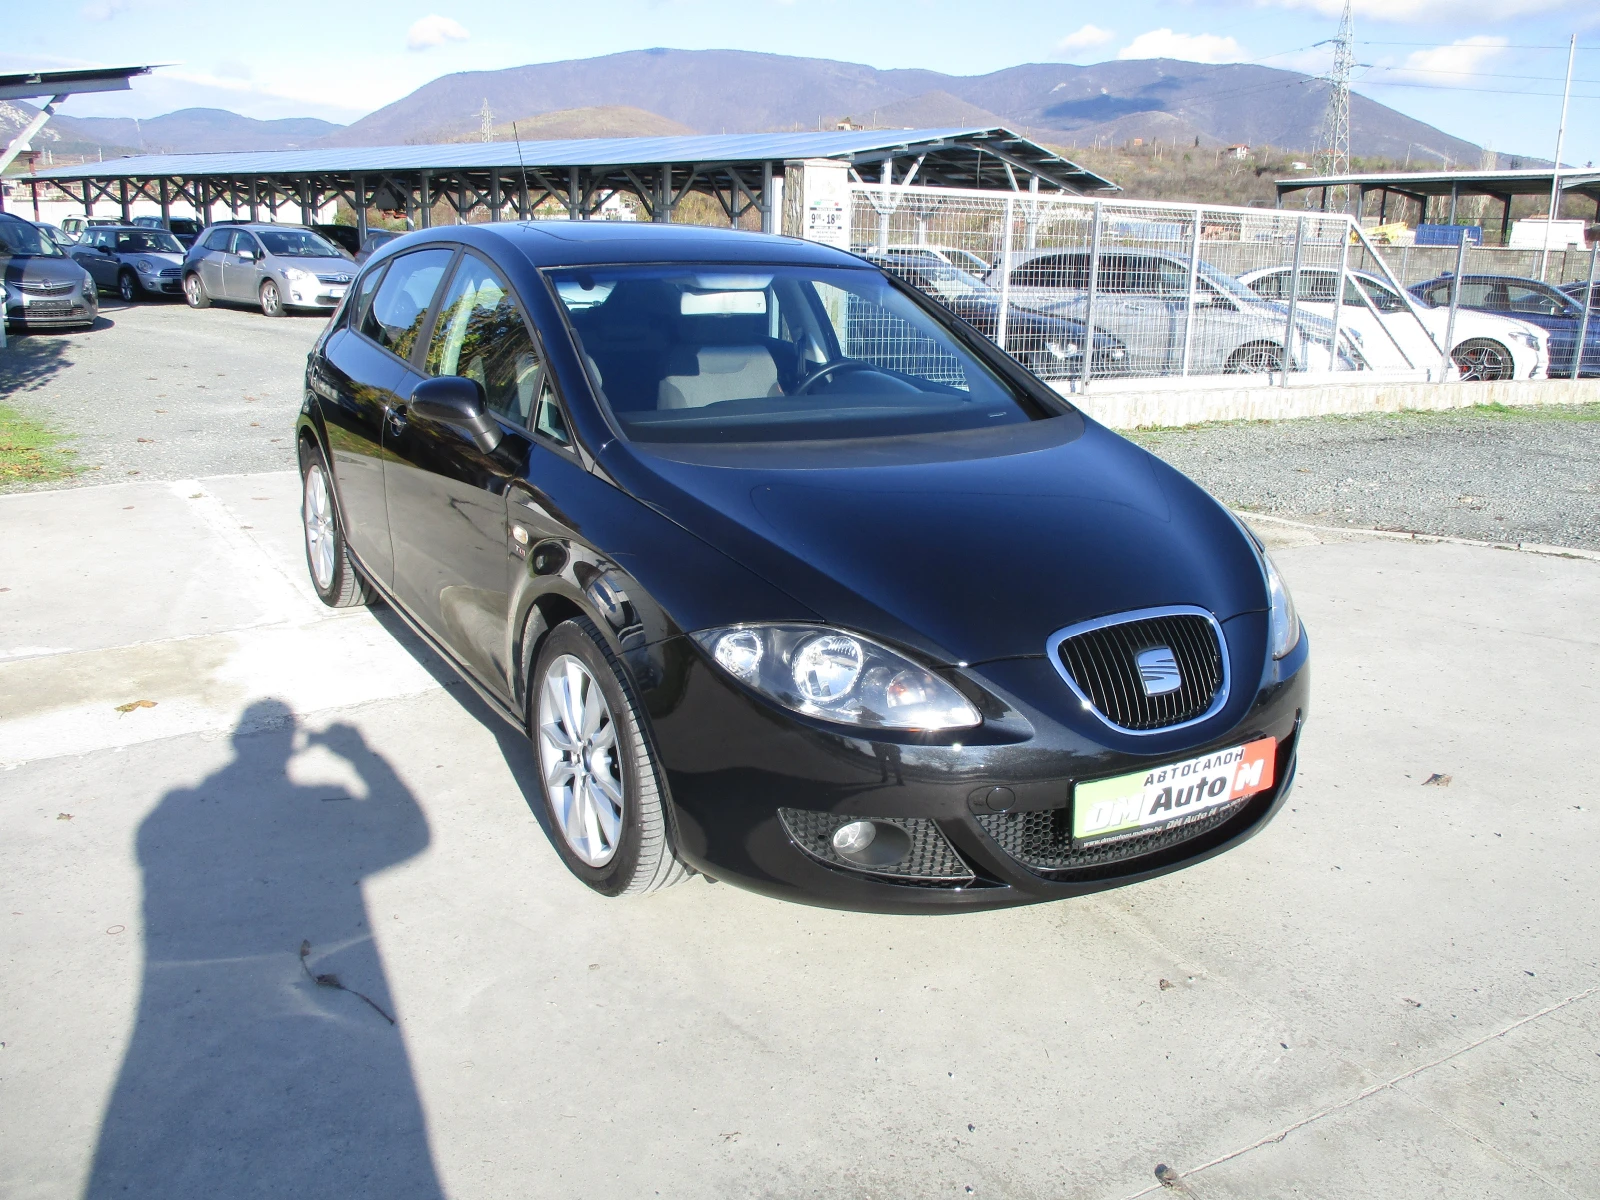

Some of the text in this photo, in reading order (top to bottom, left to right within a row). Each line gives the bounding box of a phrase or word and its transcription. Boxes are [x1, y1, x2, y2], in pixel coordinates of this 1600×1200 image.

[1143, 748, 1245, 787] АВТОСАЛОН
[1083, 793, 1145, 833] DM
[1148, 776, 1227, 816] Auto
[1234, 758, 1265, 792] M
[1184, 812, 1207, 824] Auto
